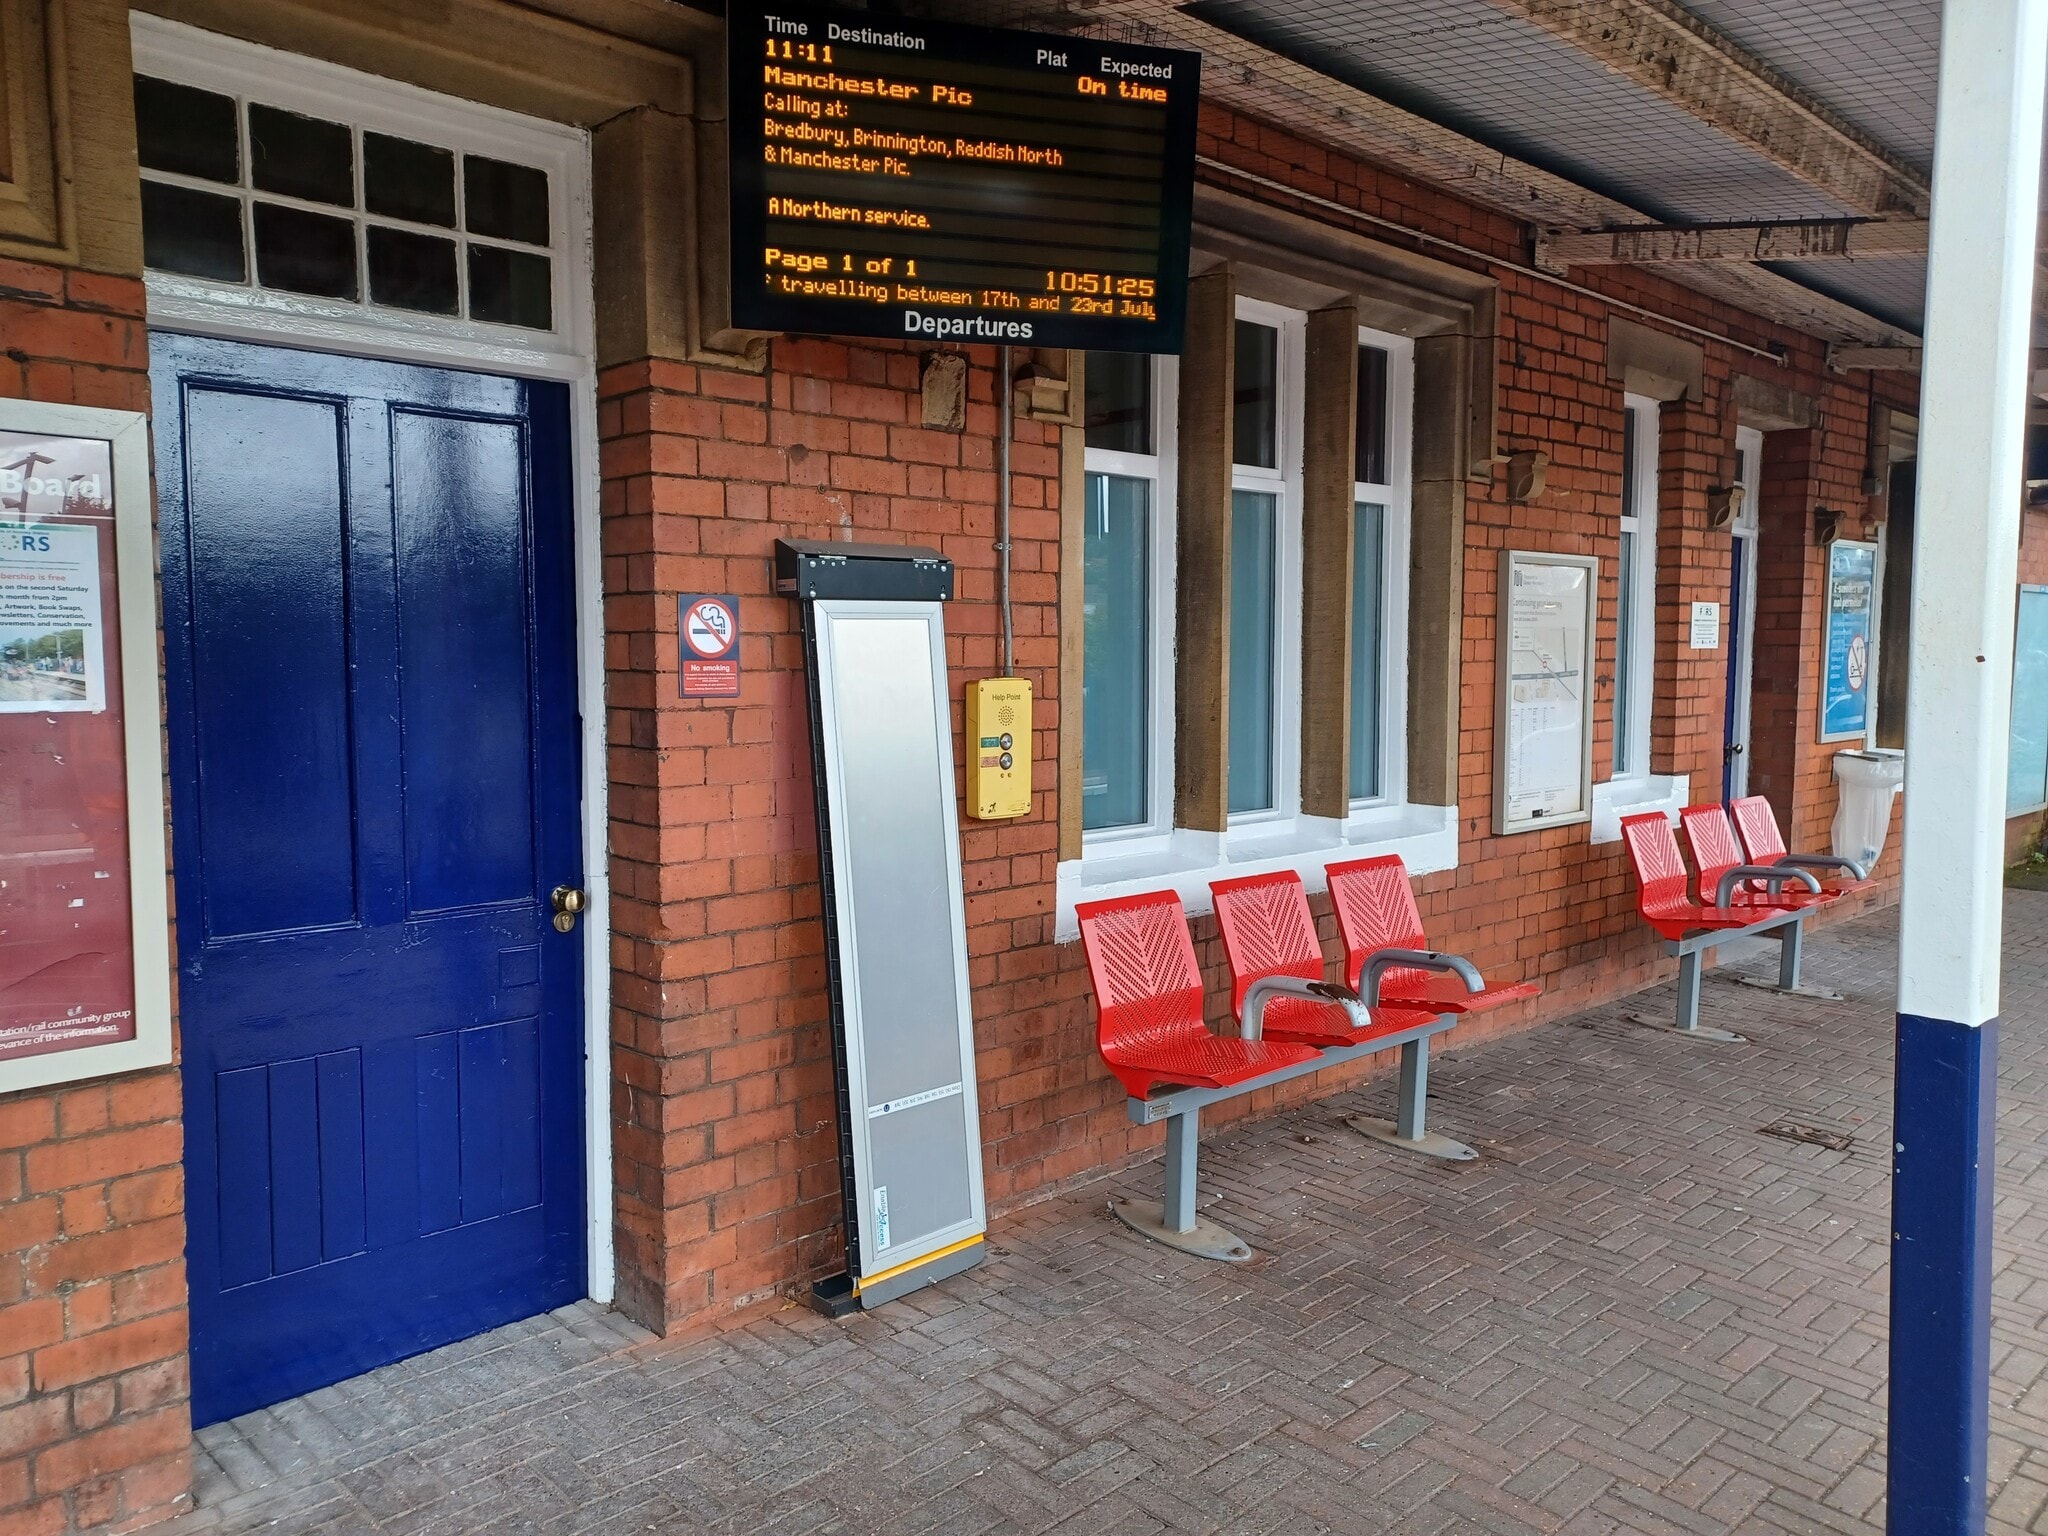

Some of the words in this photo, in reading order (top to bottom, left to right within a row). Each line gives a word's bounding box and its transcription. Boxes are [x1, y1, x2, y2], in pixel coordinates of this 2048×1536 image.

[764, 15, 809, 36] Time
[828, 22, 926, 50] Destination
[1036, 49, 1068, 68] Plat
[1100, 56, 1173, 80] Expected
[765, 38, 833, 64] 11:11
[764, 65, 920, 99] Manchester
[932, 84, 973, 106] Pic
[1077, 75, 1107, 95] On
[1118, 80, 1168, 103] time
[764, 92, 821, 119] Calling
[824, 99, 848, 118] at:
[764, 118, 850, 148] Bredbury,
[853, 127, 952, 159] Brinnington,
[955, 138, 1015, 161] Reddish
[1017, 145, 1063, 166] North
[764, 144, 777, 163] &
[780, 146, 881, 172] Manchester
[883, 156, 911, 176] Pic.
[768, 196, 780, 215] A
[783, 198, 861, 222] Northern
[864, 209, 931, 229] service.
[764, 247, 829, 273] Page
[842, 254, 854, 272] 1
[865, 257, 892, 275] of
[906, 259, 917, 277] 1
[781, 274, 888, 303] travelling
[897, 283, 973, 306] between
[981, 289, 1021, 309] 17th
[1028, 294, 1061, 311] and
[1069, 296, 1114, 315] 23rd
[1045, 270, 1155, 298] 10:51:25
[904, 309, 1034, 339] Departures
[0, 468, 102, 499] Board
[16, 583, 29, 591] the
[30, 584, 56, 592] second
[57, 585, 89, 593] Saturday
[38, 573, 46, 581] is
[48, 573, 66, 582] free
[5, 593, 31, 601] month
[32, 593, 50, 602] from
[51, 594, 68, 602] 2pm
[37, 620, 51, 628] and
[691, 664, 701, 672] No
[702, 664, 730, 673] smoking
[1006, 693, 1021, 701] Point
[47, 1013, 102, 1029] community
[103, 1009, 132, 1022] group
[33, 1033, 46, 1044] of
[46, 1031, 60, 1042] the
